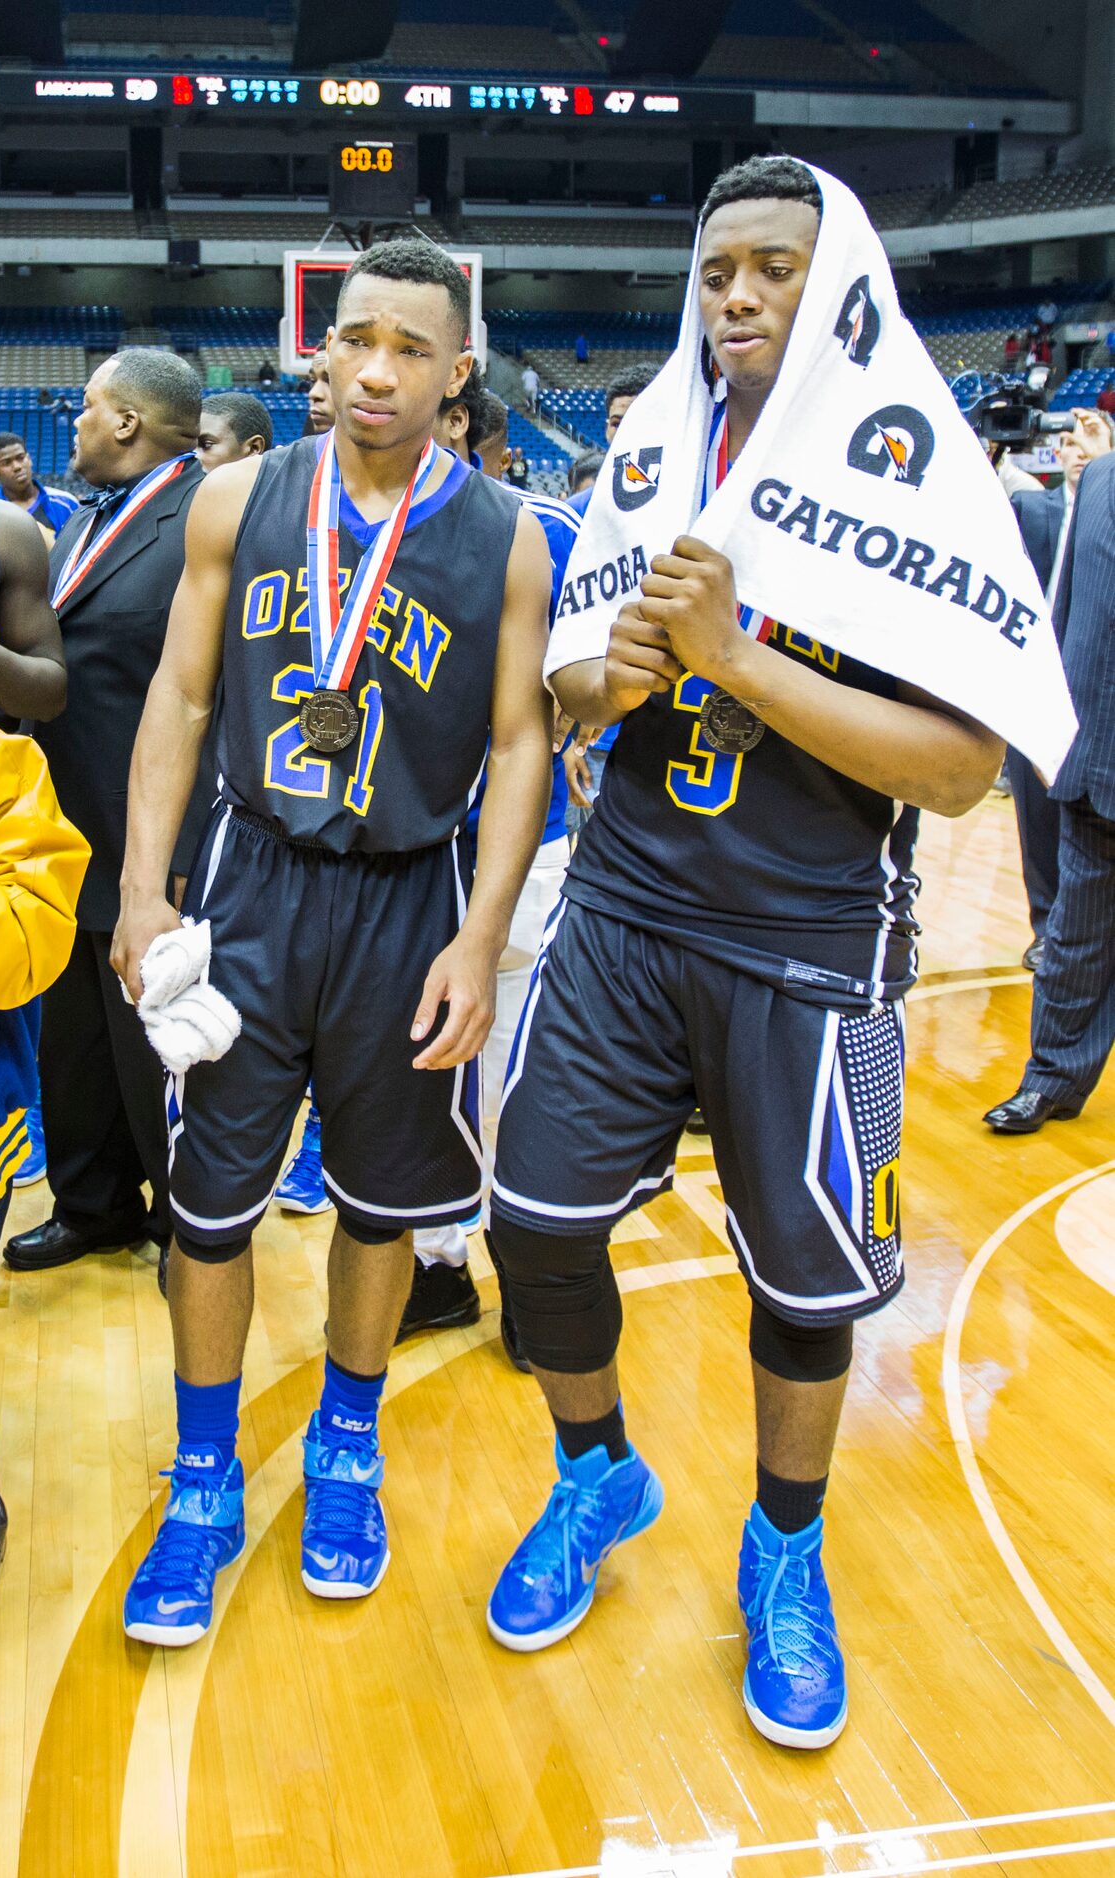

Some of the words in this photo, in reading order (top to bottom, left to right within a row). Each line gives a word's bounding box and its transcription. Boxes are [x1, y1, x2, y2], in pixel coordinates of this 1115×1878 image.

[320, 80, 380, 106] 0:00
[405, 85, 451, 107] 4TH
[604, 91, 635, 113] 47
[341, 147, 393, 172] 00.0
[557, 545, 648, 619] ATORA
[750, 477, 1039, 650] GATORADE
[264, 662, 385, 817] 21
[665, 671, 744, 818] 3
